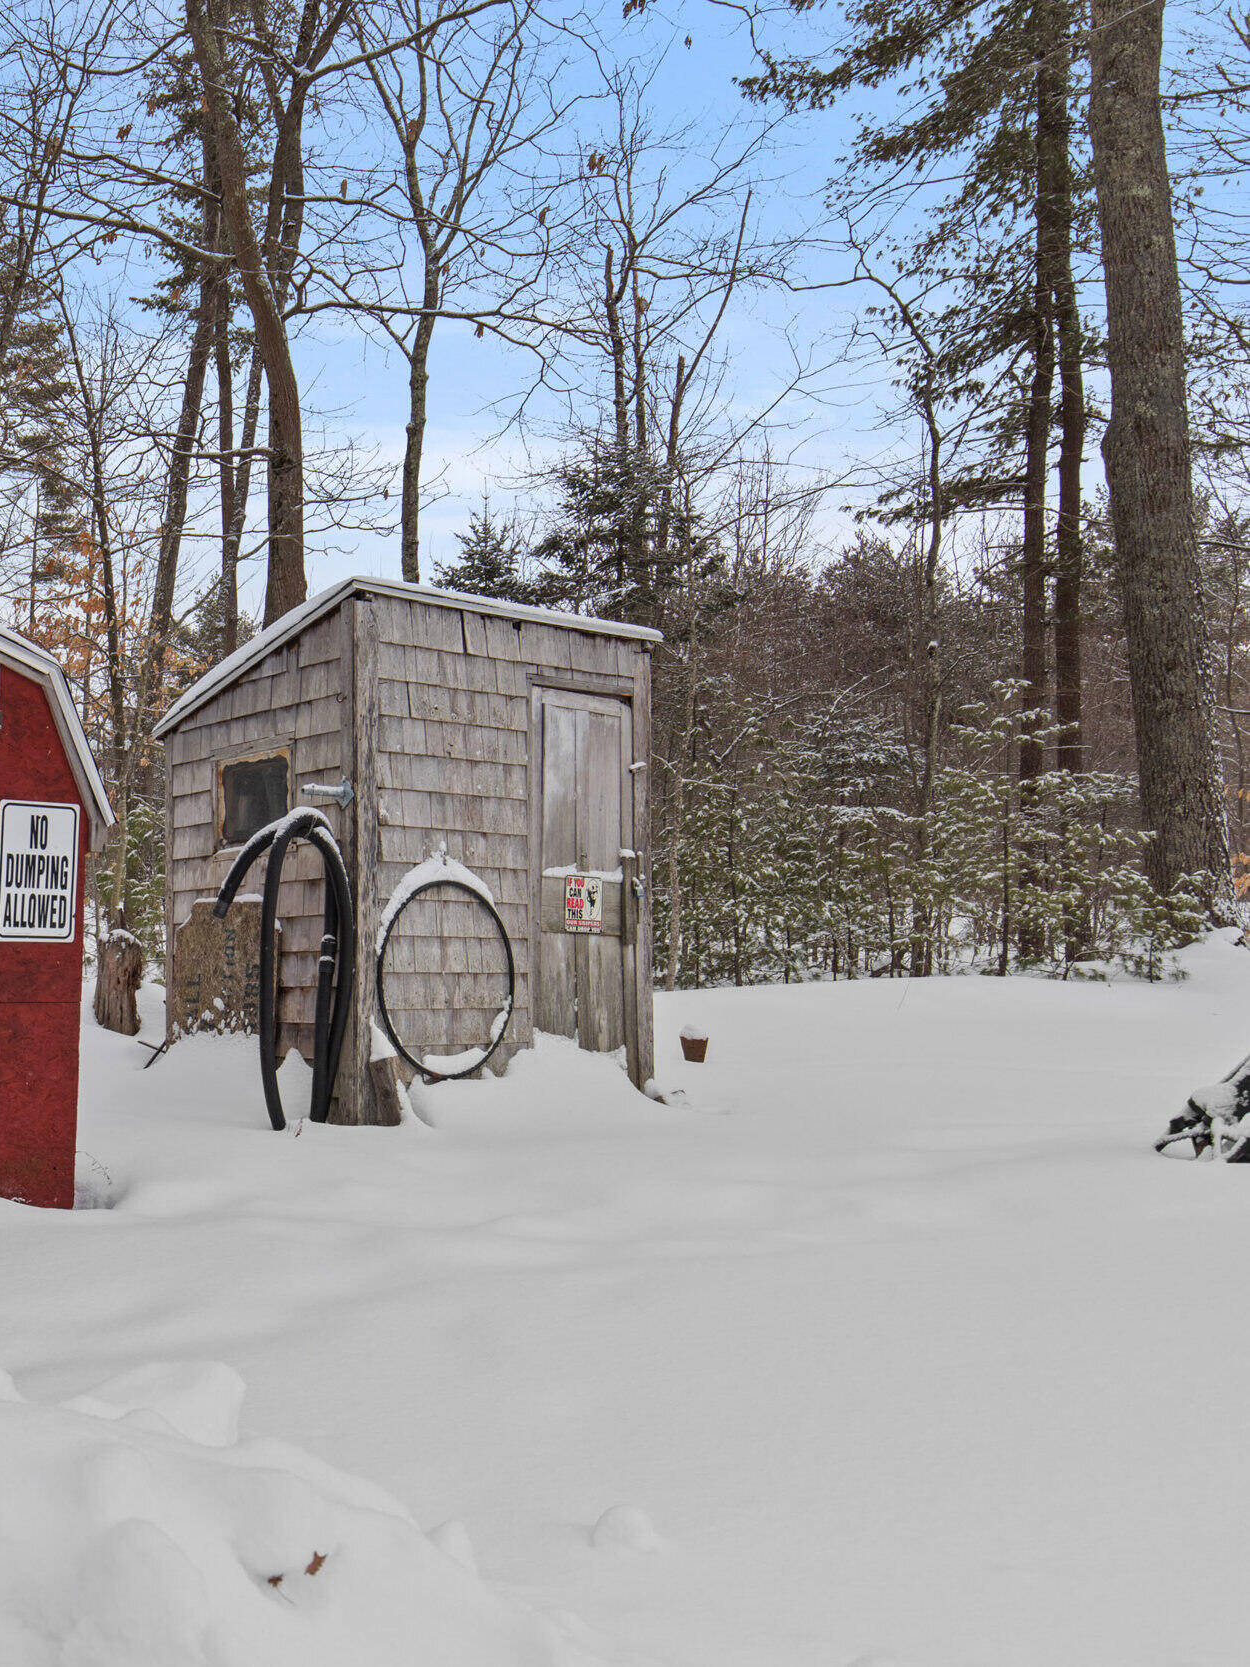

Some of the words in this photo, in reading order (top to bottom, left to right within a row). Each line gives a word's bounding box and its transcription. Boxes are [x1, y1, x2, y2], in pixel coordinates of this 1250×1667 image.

[30, 815, 48, 850] NO
[5, 853, 69, 890] DUMPING
[574, 878, 585, 888] YOU
[569, 887, 582, 898] CAN
[566, 897, 584, 909] READ
[3, 893, 67, 929] ALLOWED
[567, 909, 583, 919] THIS
